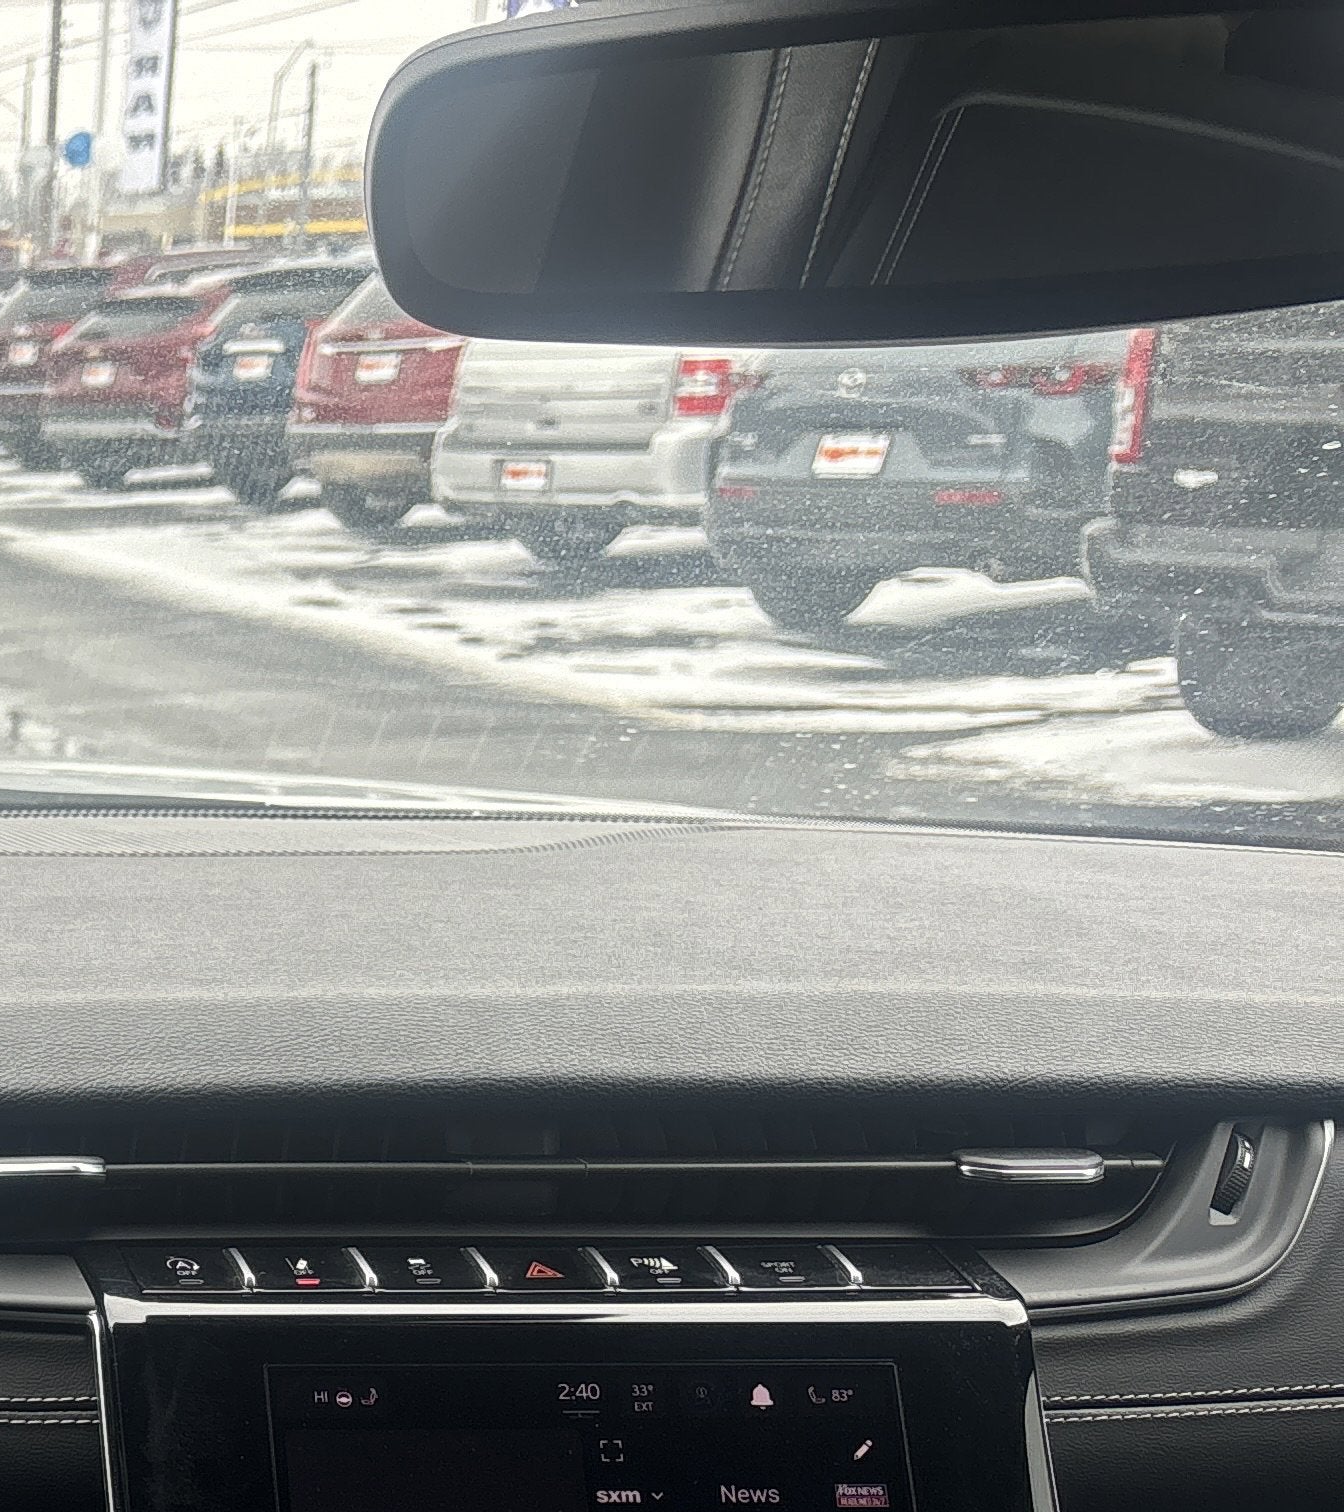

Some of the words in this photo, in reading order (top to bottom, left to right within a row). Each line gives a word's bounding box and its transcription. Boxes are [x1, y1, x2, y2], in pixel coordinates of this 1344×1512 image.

[314, 1391, 329, 1404] HI
[558, 1383, 600, 1400] 2:40
[632, 1385, 654, 1397] 33°
[634, 1401, 654, 1412] EXT
[596, 1490, 642, 1504] sxm
[720, 1485, 780, 1504] News
